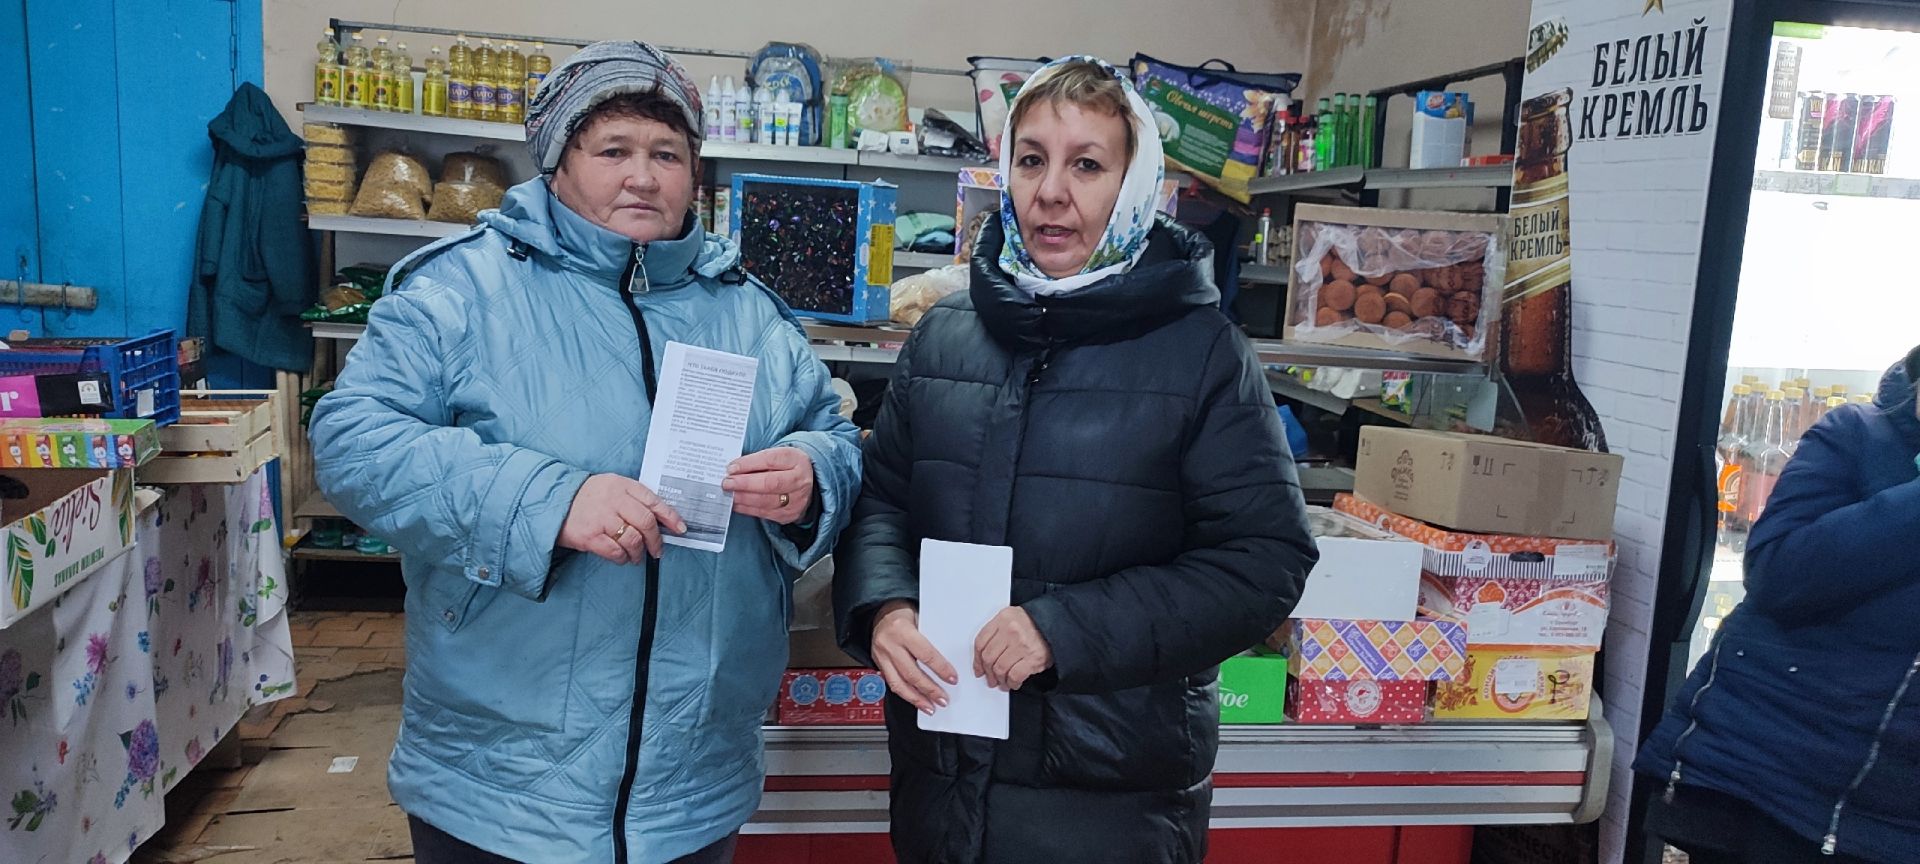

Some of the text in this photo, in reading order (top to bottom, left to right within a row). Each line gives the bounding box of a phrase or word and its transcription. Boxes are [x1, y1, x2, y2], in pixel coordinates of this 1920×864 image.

[1590, 16, 1709, 88] БЕЛЫЙ
[1577, 83, 1708, 140] КРЕМЛЬ
[1513, 206, 1560, 238] БЕЛЫЙ
[1510, 234, 1563, 261] КРЕМЛЬ
[81, 545, 104, 571] PREMIUM
[54, 561, 80, 588] BANANAS
